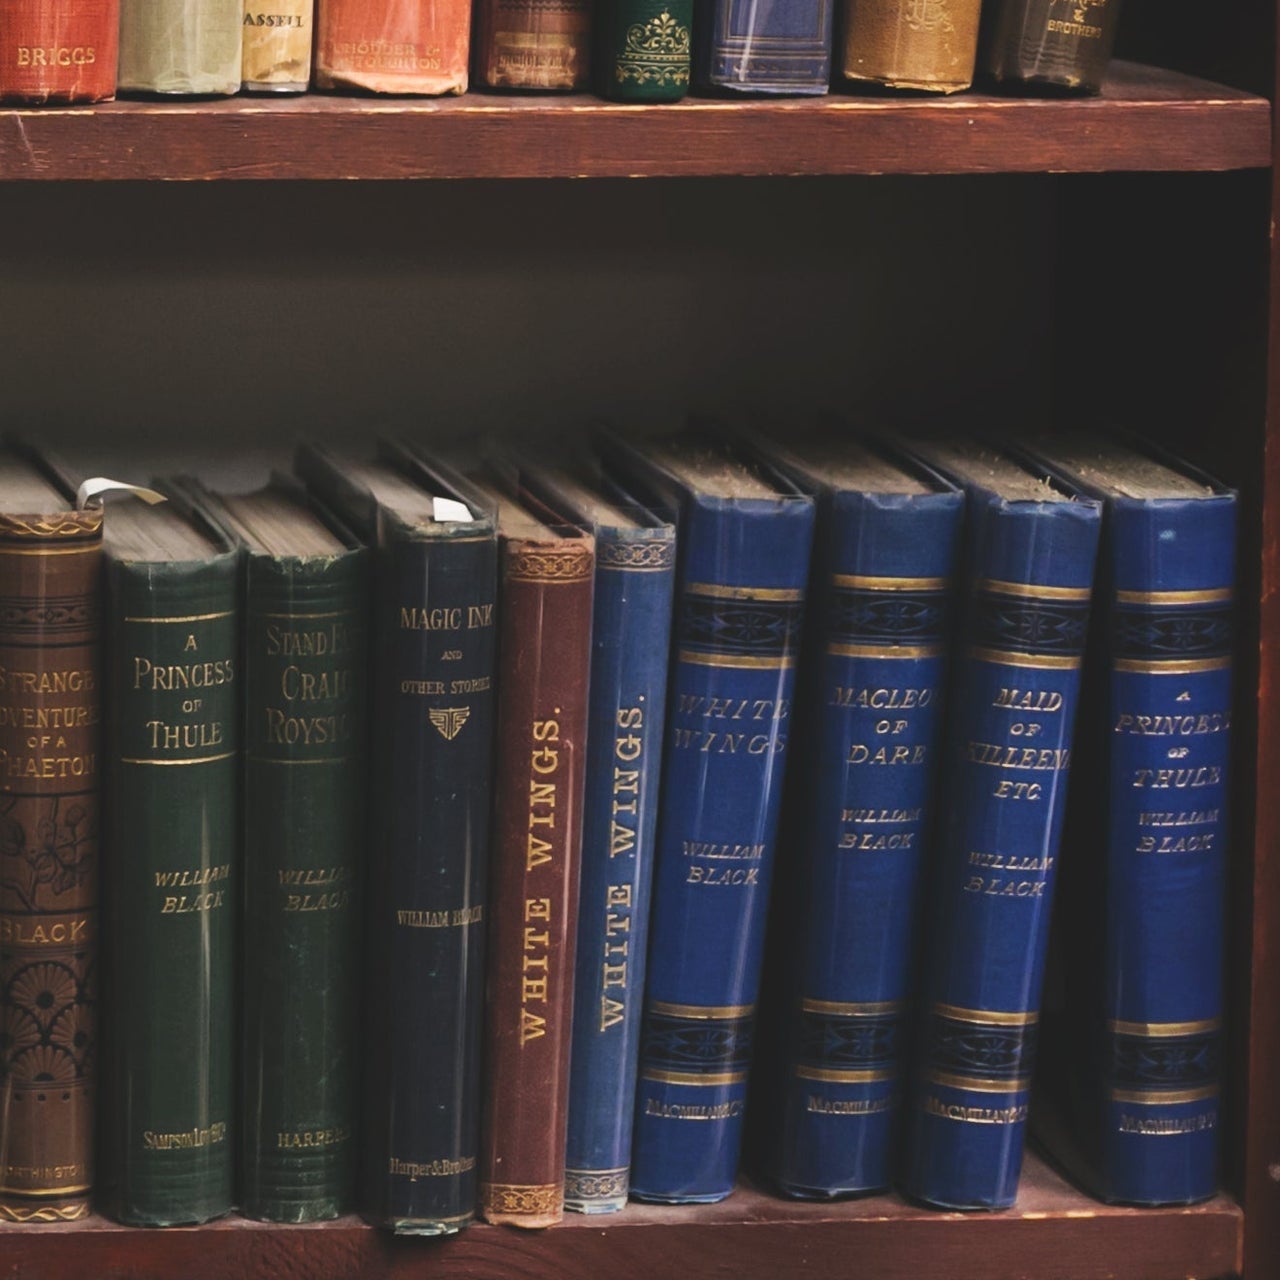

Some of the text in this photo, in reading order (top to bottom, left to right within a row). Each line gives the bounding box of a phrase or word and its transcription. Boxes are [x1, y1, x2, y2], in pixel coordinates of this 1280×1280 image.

[17, 47, 96, 68] BRIGGS
[401, 605, 493, 629] MAGIC INK
[184, 635, 197, 651] A
[134, 657, 234, 691] PRINCESS
[401, 679, 445, 695] OTHER
[678, 695, 787, 720] WHITE
[993, 689, 1063, 711] MAID
[147, 720, 223, 750] THULE
[876, 720, 908, 735] OF
[1010, 723, 1041, 736] OF
[674, 729, 785, 754] WINGS
[847, 745, 926, 765] DARE
[1133, 767, 1221, 788] THULE
[839, 833, 914, 850] BLACK
[687, 867, 759, 885] BLACK
[964, 877, 1047, 897] BLACK
[601, 883, 632, 1032] WHITE
[520, 898, 551, 1047] WHITE
